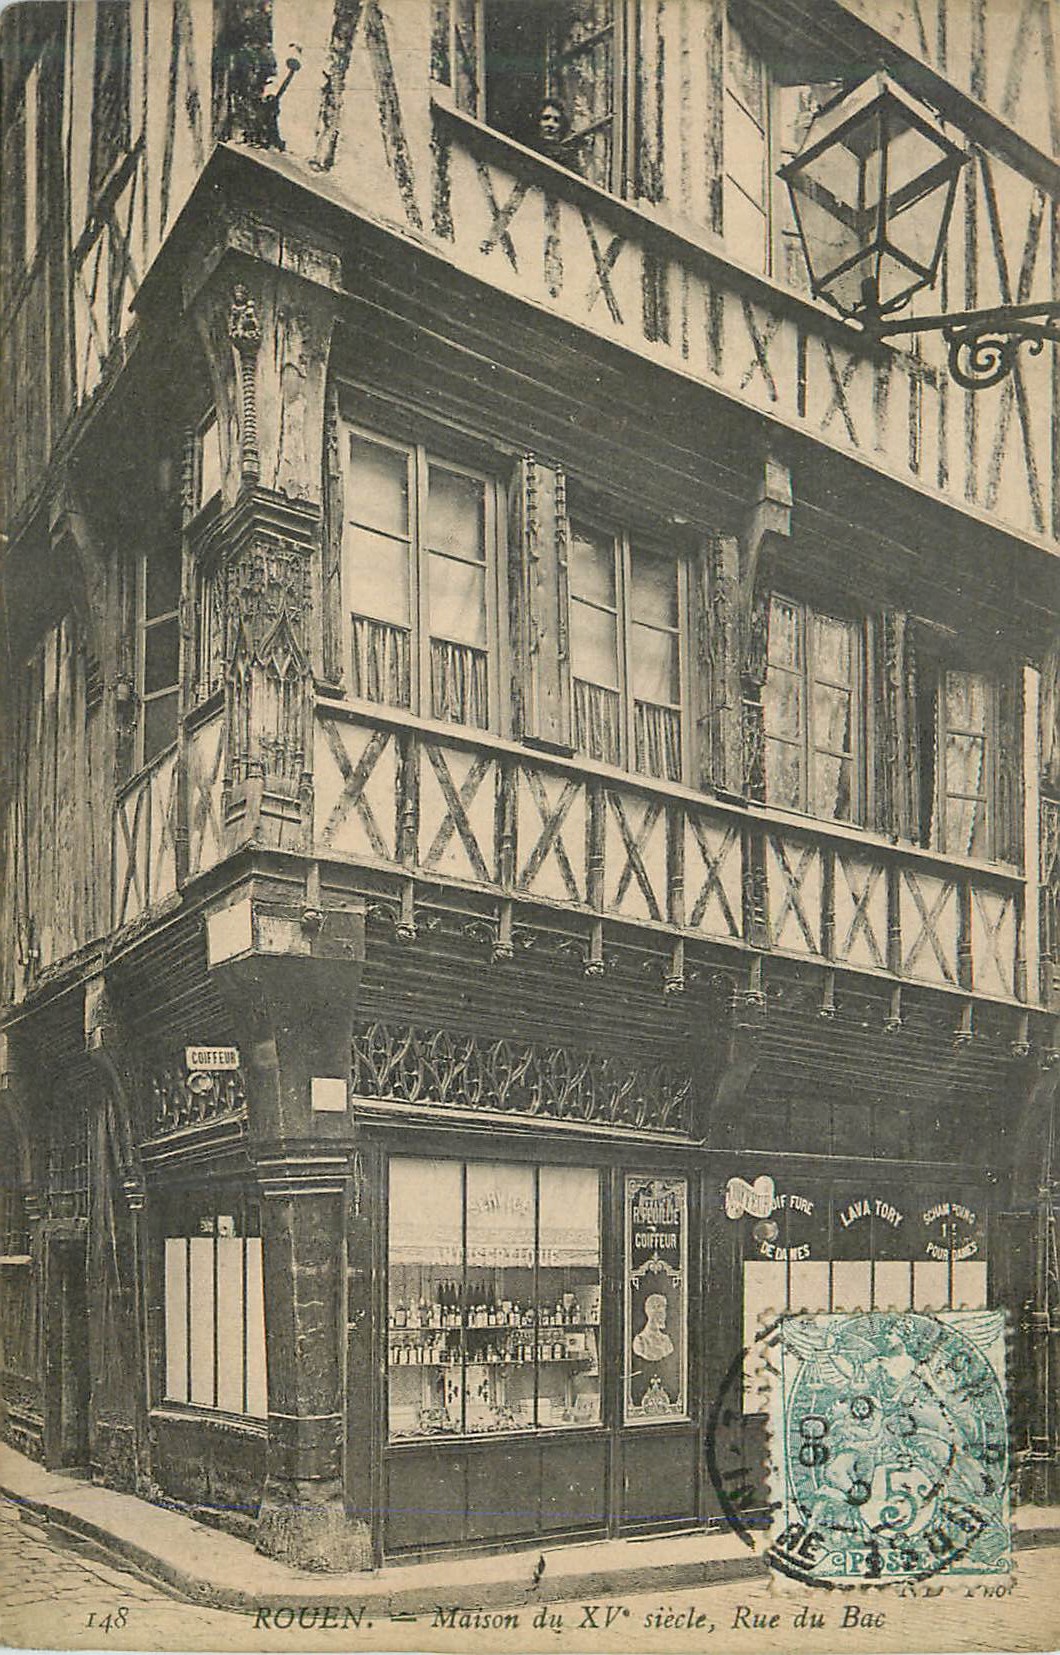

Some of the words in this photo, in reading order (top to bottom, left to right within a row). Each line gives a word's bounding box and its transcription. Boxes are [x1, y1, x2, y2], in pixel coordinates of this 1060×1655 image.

[191, 1051, 237, 1065] COIFFEUR
[634, 1232, 678, 1250] COIFFEUR
[760, 1240, 775, 1258] DE
[775, 1243, 811, 1261] DAMES
[926, 1242, 949, 1261] POUR
